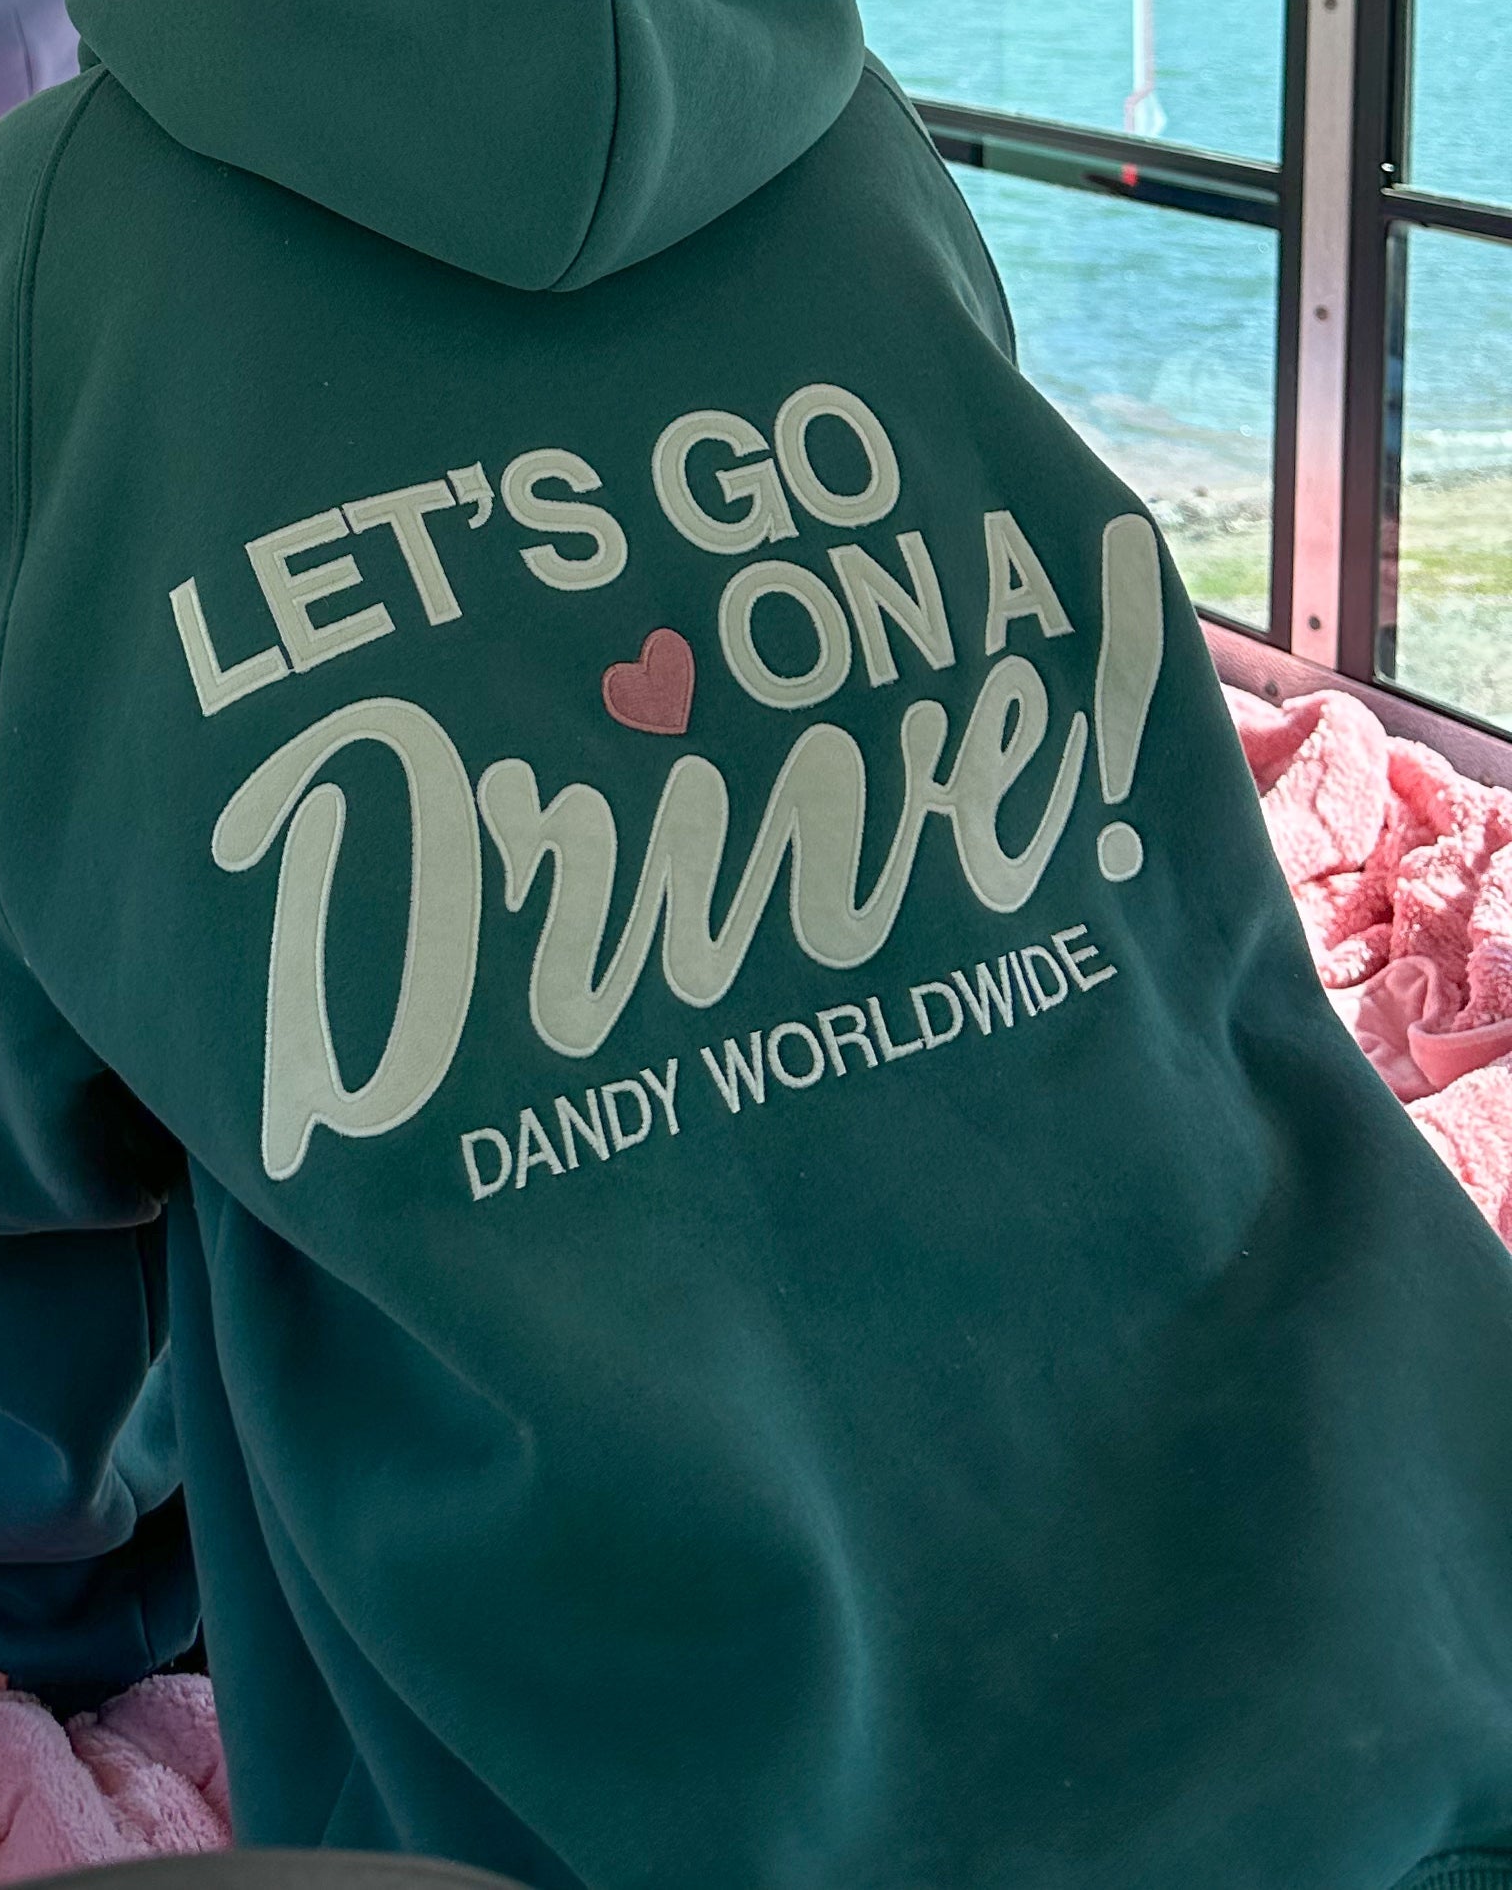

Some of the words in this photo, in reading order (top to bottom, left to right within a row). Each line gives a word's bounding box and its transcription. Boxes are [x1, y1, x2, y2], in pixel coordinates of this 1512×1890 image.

[168, 447, 628, 717] LET'S
[651, 383, 900, 555] GO
[718, 530, 956, 710] ON
[984, 510, 1076, 655] A
[211, 513, 1164, 1181] Drive!
[461, 1058, 682, 1202] DANDY
[700, 924, 1118, 1113] WORLDWIDE
